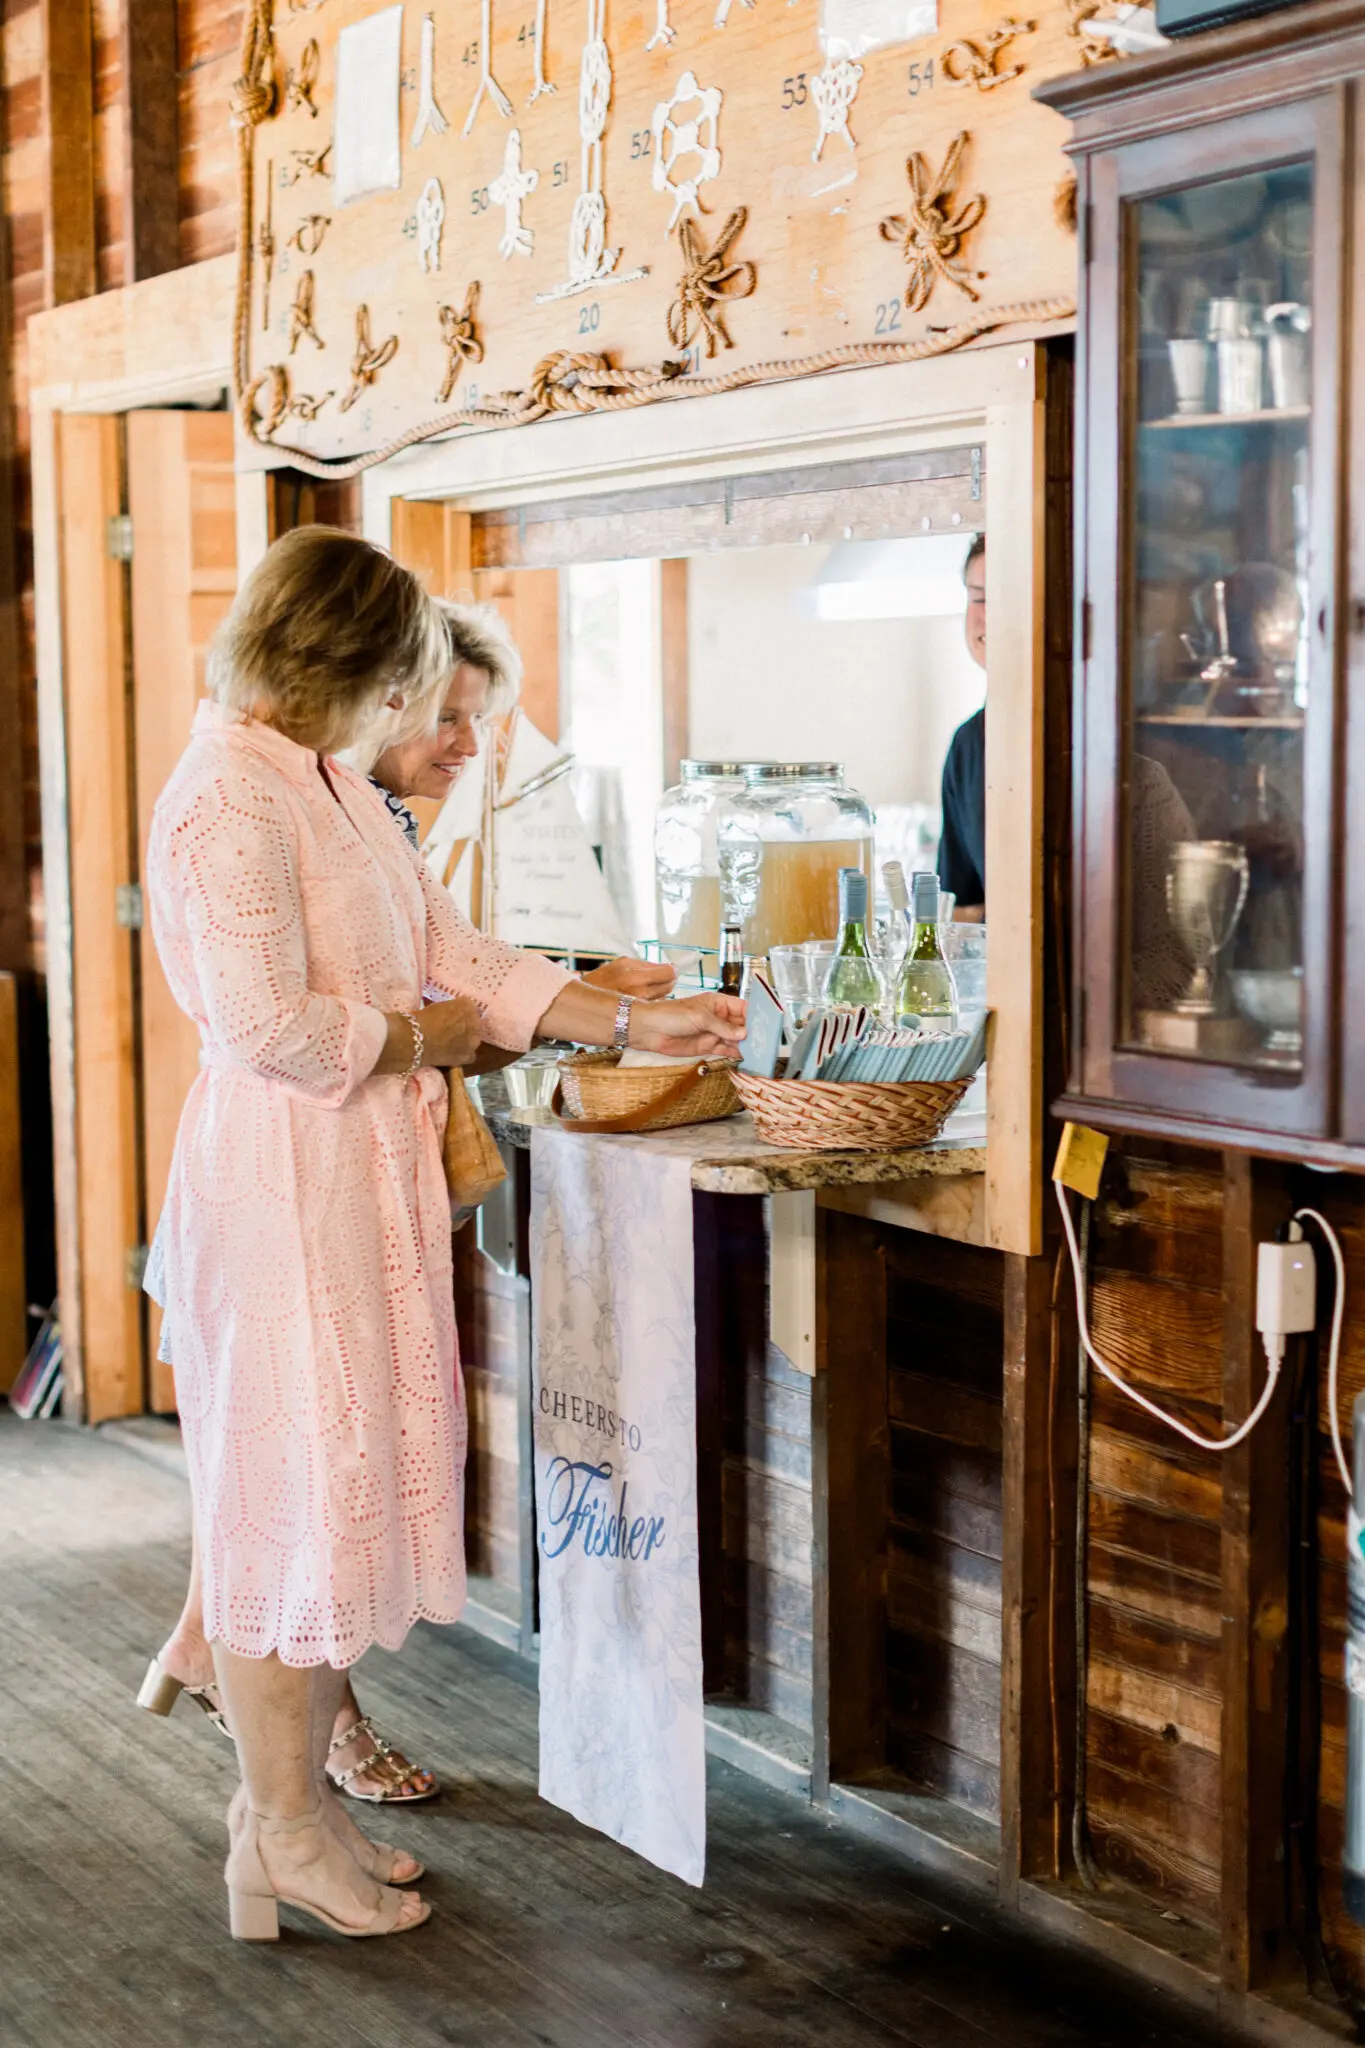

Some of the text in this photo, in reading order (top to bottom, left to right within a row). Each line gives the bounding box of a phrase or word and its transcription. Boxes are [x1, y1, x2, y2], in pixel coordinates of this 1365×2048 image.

[782, 74, 808, 110] 53
[907, 58, 935, 95] 54
[630, 130, 651, 160] 52
[552, 161, 569, 188] 51
[470, 186, 489, 216] 50
[579, 302, 600, 335] 20
[874, 298, 901, 336] 22
[681, 345, 701, 376] 21
[539, 1387, 642, 1453] CHEERS TO
[540, 1456, 666, 1561] Fischer
